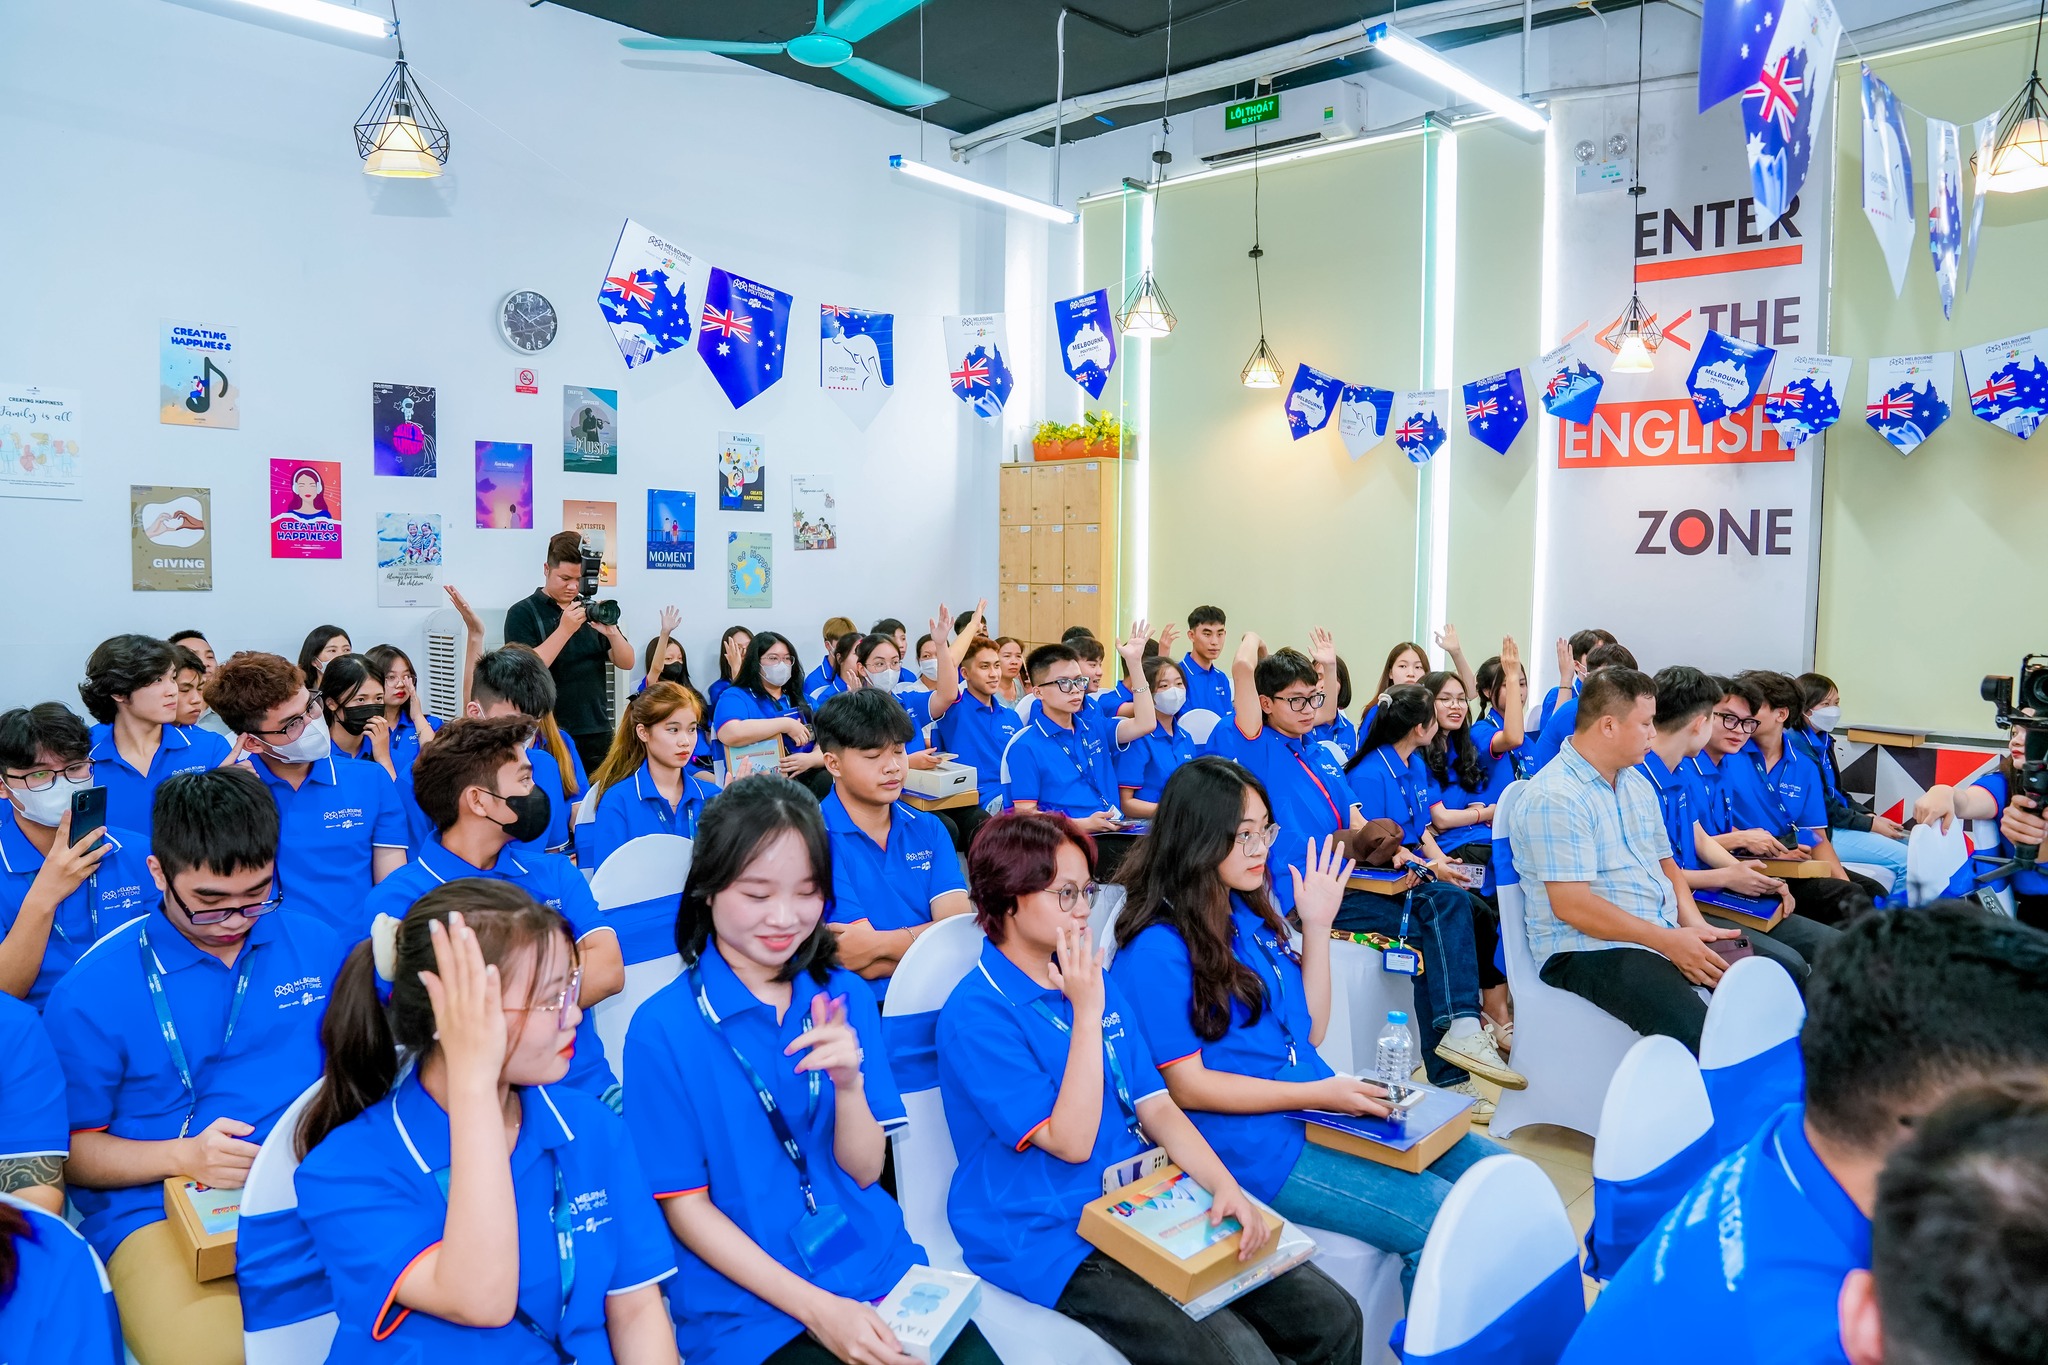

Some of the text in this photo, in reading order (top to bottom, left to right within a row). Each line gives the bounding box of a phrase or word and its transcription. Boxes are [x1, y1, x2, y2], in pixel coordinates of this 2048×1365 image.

[1246, 101, 1274, 116] THOÁT
[1241, 114, 1262, 124] EXIT
[1636, 194, 1802, 258] ENTER
[664, 242, 692, 261] MELBOURNE
[748, 283, 775, 297] MELBOURNE
[1700, 296, 1800, 346] THE
[173, 327, 227, 340] CREATING
[2001, 335, 2031, 346] MELBOURNE
[171, 337, 232, 351] HAPPINESS
[1072, 336, 1104, 350] MELBOURNE
[1705, 369, 1745, 386] MELBOURNE
[8, 396, 34, 404] CREATING
[1296, 394, 1323, 411] MELBOURNE
[1565, 404, 1789, 460] ENGLISH
[281, 522, 334, 531] CREATING
[1635, 508, 1793, 555] ZONE
[277, 531, 339, 541] HAPPINESS
[152, 558, 205, 568] GIVING
[649, 551, 692, 563] MOMENT
[729, 563, 740, 595] World
[738, 551, 746, 562] of
